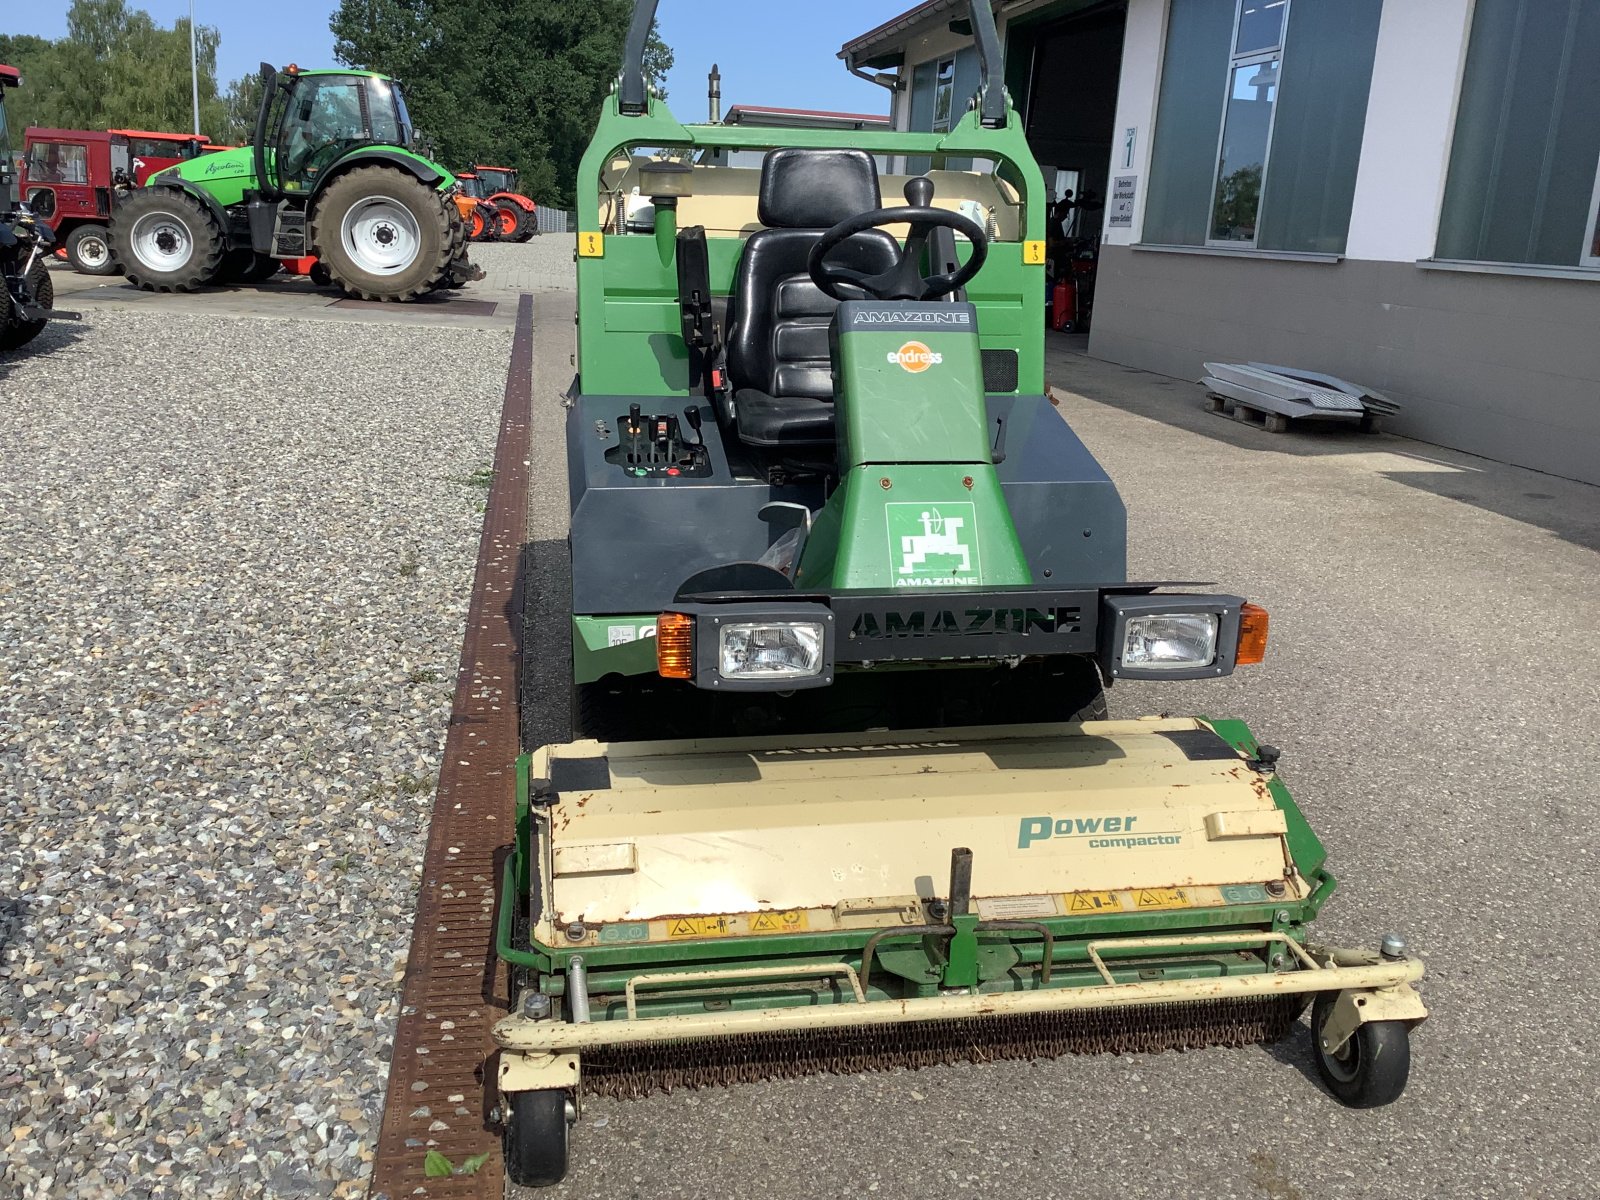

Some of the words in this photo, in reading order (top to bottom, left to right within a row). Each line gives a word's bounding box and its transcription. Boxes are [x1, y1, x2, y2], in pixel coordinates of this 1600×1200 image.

[1126, 136, 1133, 167] 1
[853, 311, 970, 323] AMAZONE
[887, 350, 943, 364] endress
[896, 577, 979, 587] AMAZONE
[850, 607, 1081, 638] AMAZONE
[1018, 816, 1137, 849] Power
[1089, 835, 1182, 849] compactor
